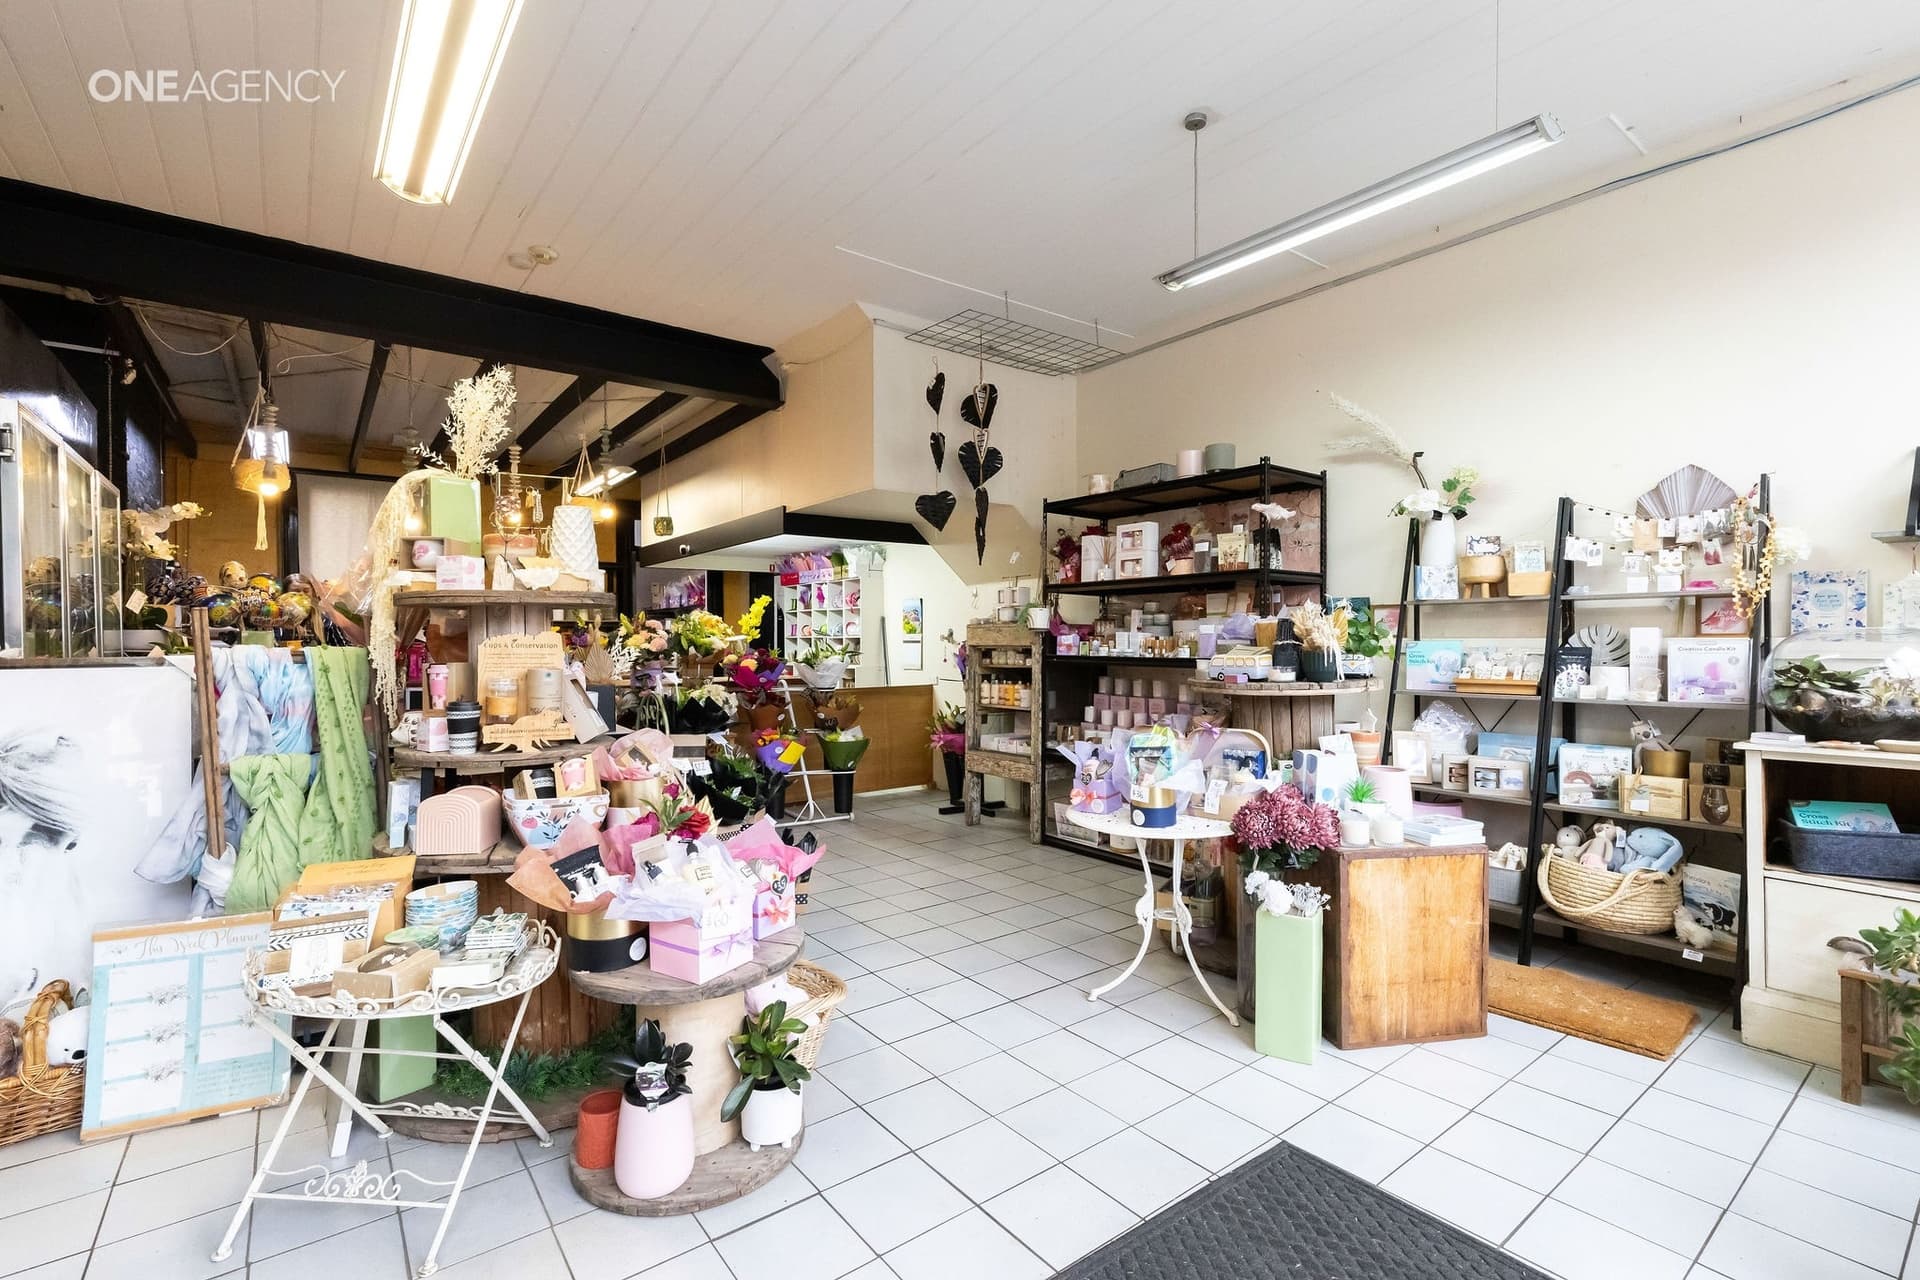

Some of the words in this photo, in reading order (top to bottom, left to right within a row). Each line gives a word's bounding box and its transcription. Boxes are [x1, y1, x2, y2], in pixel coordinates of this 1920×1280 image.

[510, 642, 559, 650] Conservation
[1799, 812, 1829, 820] Cross
[1801, 818, 1833, 826] Stitch
